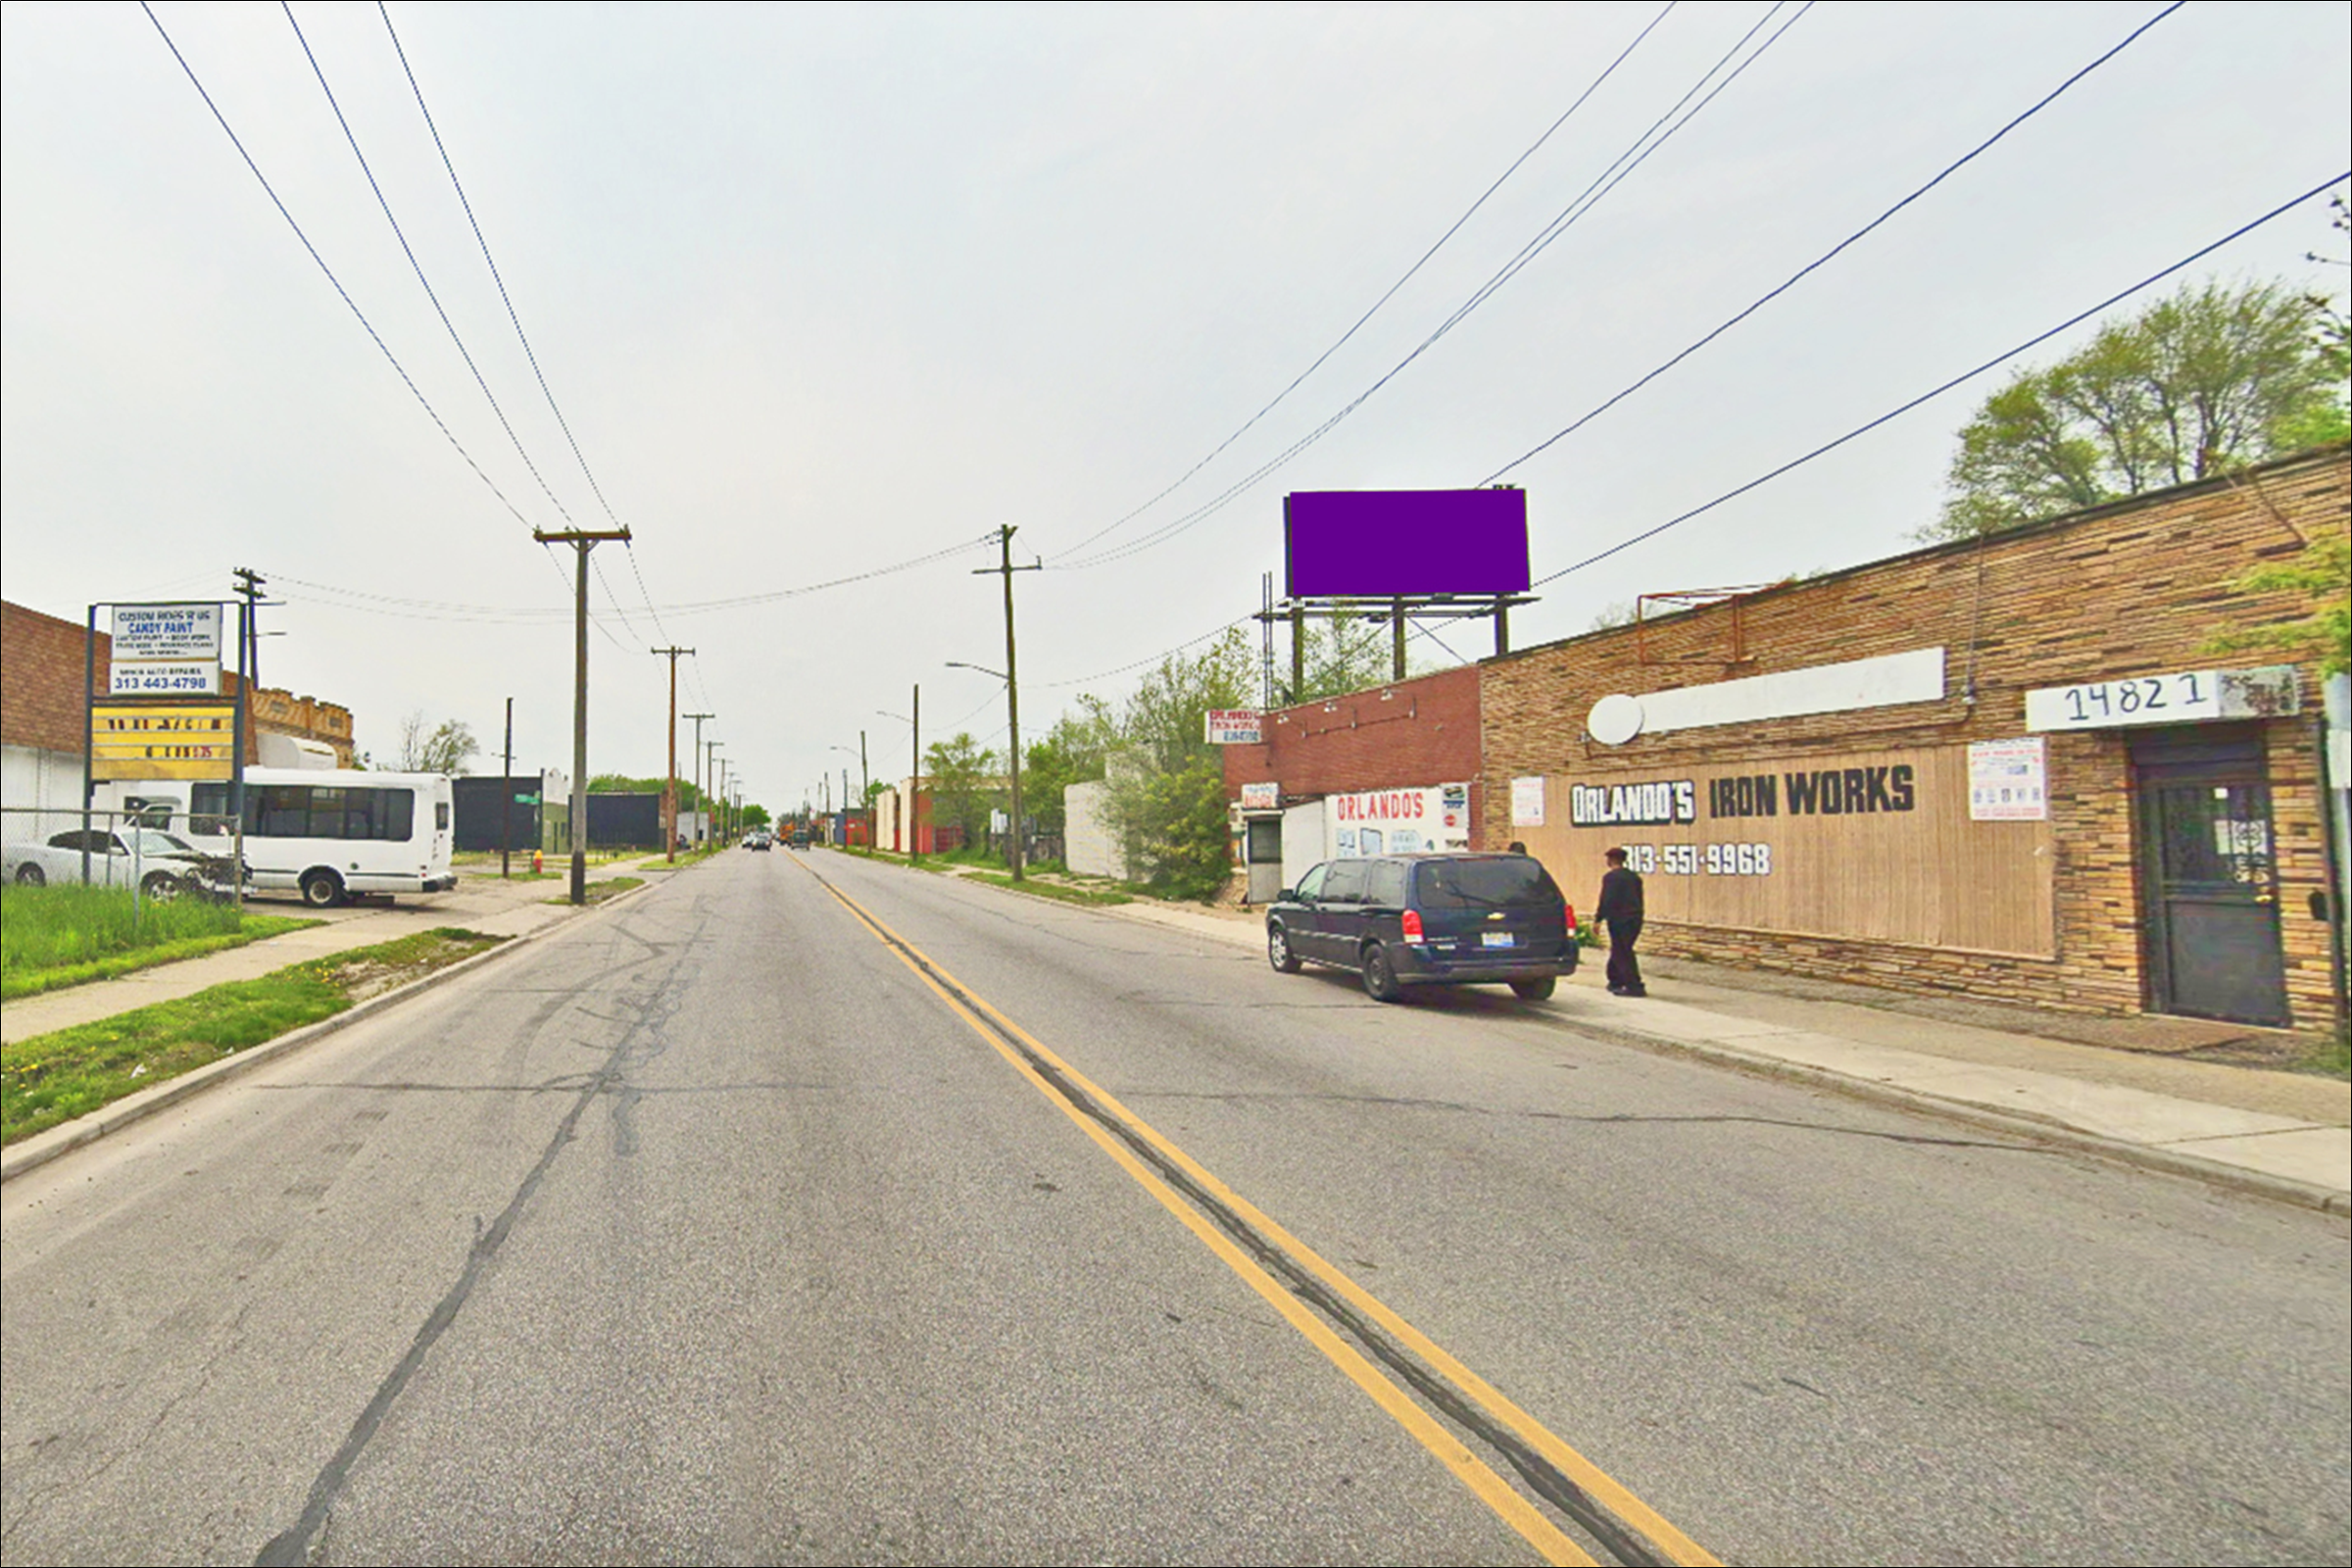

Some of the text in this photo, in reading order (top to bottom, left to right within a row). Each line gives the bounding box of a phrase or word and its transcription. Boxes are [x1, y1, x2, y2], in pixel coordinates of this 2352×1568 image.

[118, 612, 155, 621] CUSTOM
[197, 611, 211, 619] US
[127, 621, 194, 633] CANDY PAINT
[115, 678, 139, 688] 313
[2065, 673, 2207, 720] 14821
[1570, 764, 1915, 827] ORLANDO'S IRON WORKS
[1338, 792, 1424, 821] ORLANDO'S
